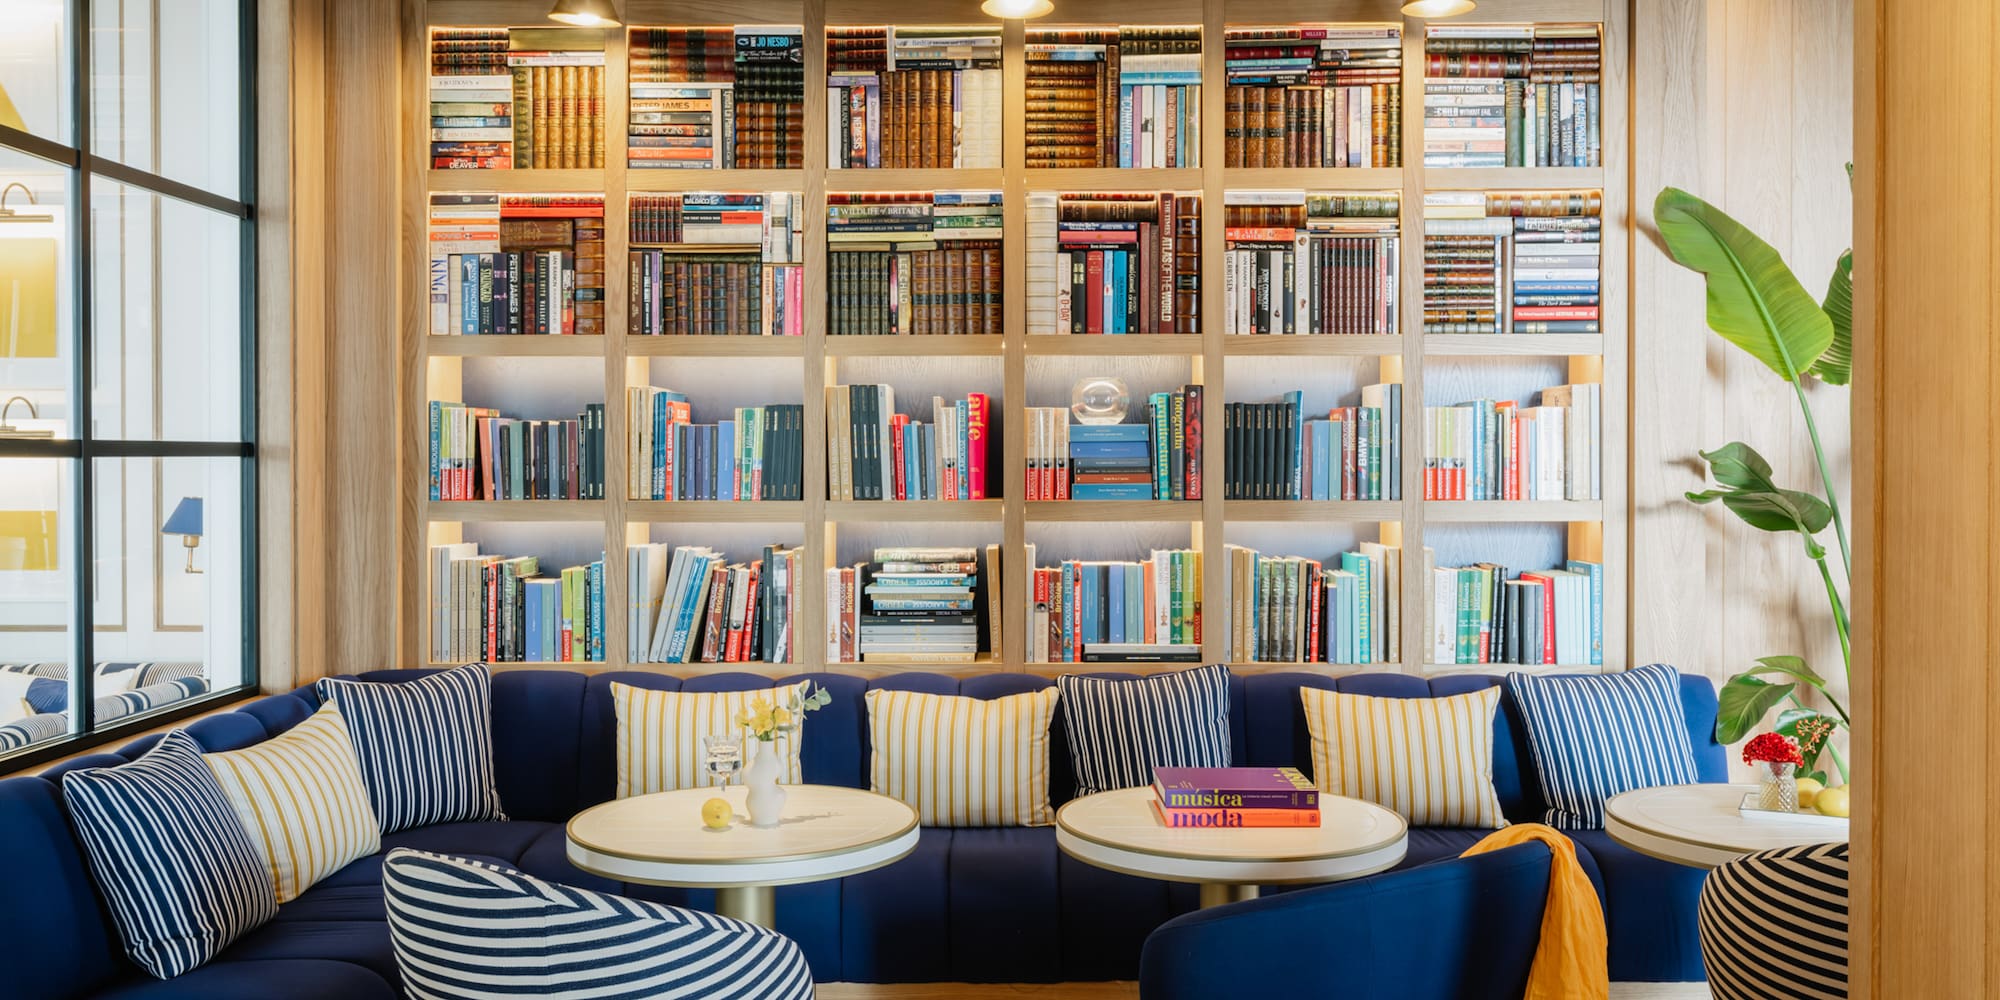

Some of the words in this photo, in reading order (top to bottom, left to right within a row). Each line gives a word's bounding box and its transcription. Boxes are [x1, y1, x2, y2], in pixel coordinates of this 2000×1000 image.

[757, 37, 766, 47] JO
[662, 102, 690, 110] JAMES
[853, 116, 862, 150] NEMESIS
[449, 161, 478, 169] DEAVER
[888, 207, 921, 215] BRITAIN
[432, 260, 447, 290] KING
[510, 254, 518, 282] PETER
[480, 268, 492, 303] STALINGRAD
[510, 283, 518, 313] JAMES
[1060, 299, 1069, 321] D-DAY
[1161, 290, 1172, 322] WORLD
[968, 395, 984, 441] arte
[1157, 397, 1169, 476] arquitectura
[1358, 436, 1367, 467] BMW
[1064, 567, 1072, 594] PERRO
[1171, 789, 1243, 806] música
[1173, 809, 1243, 827] moda
